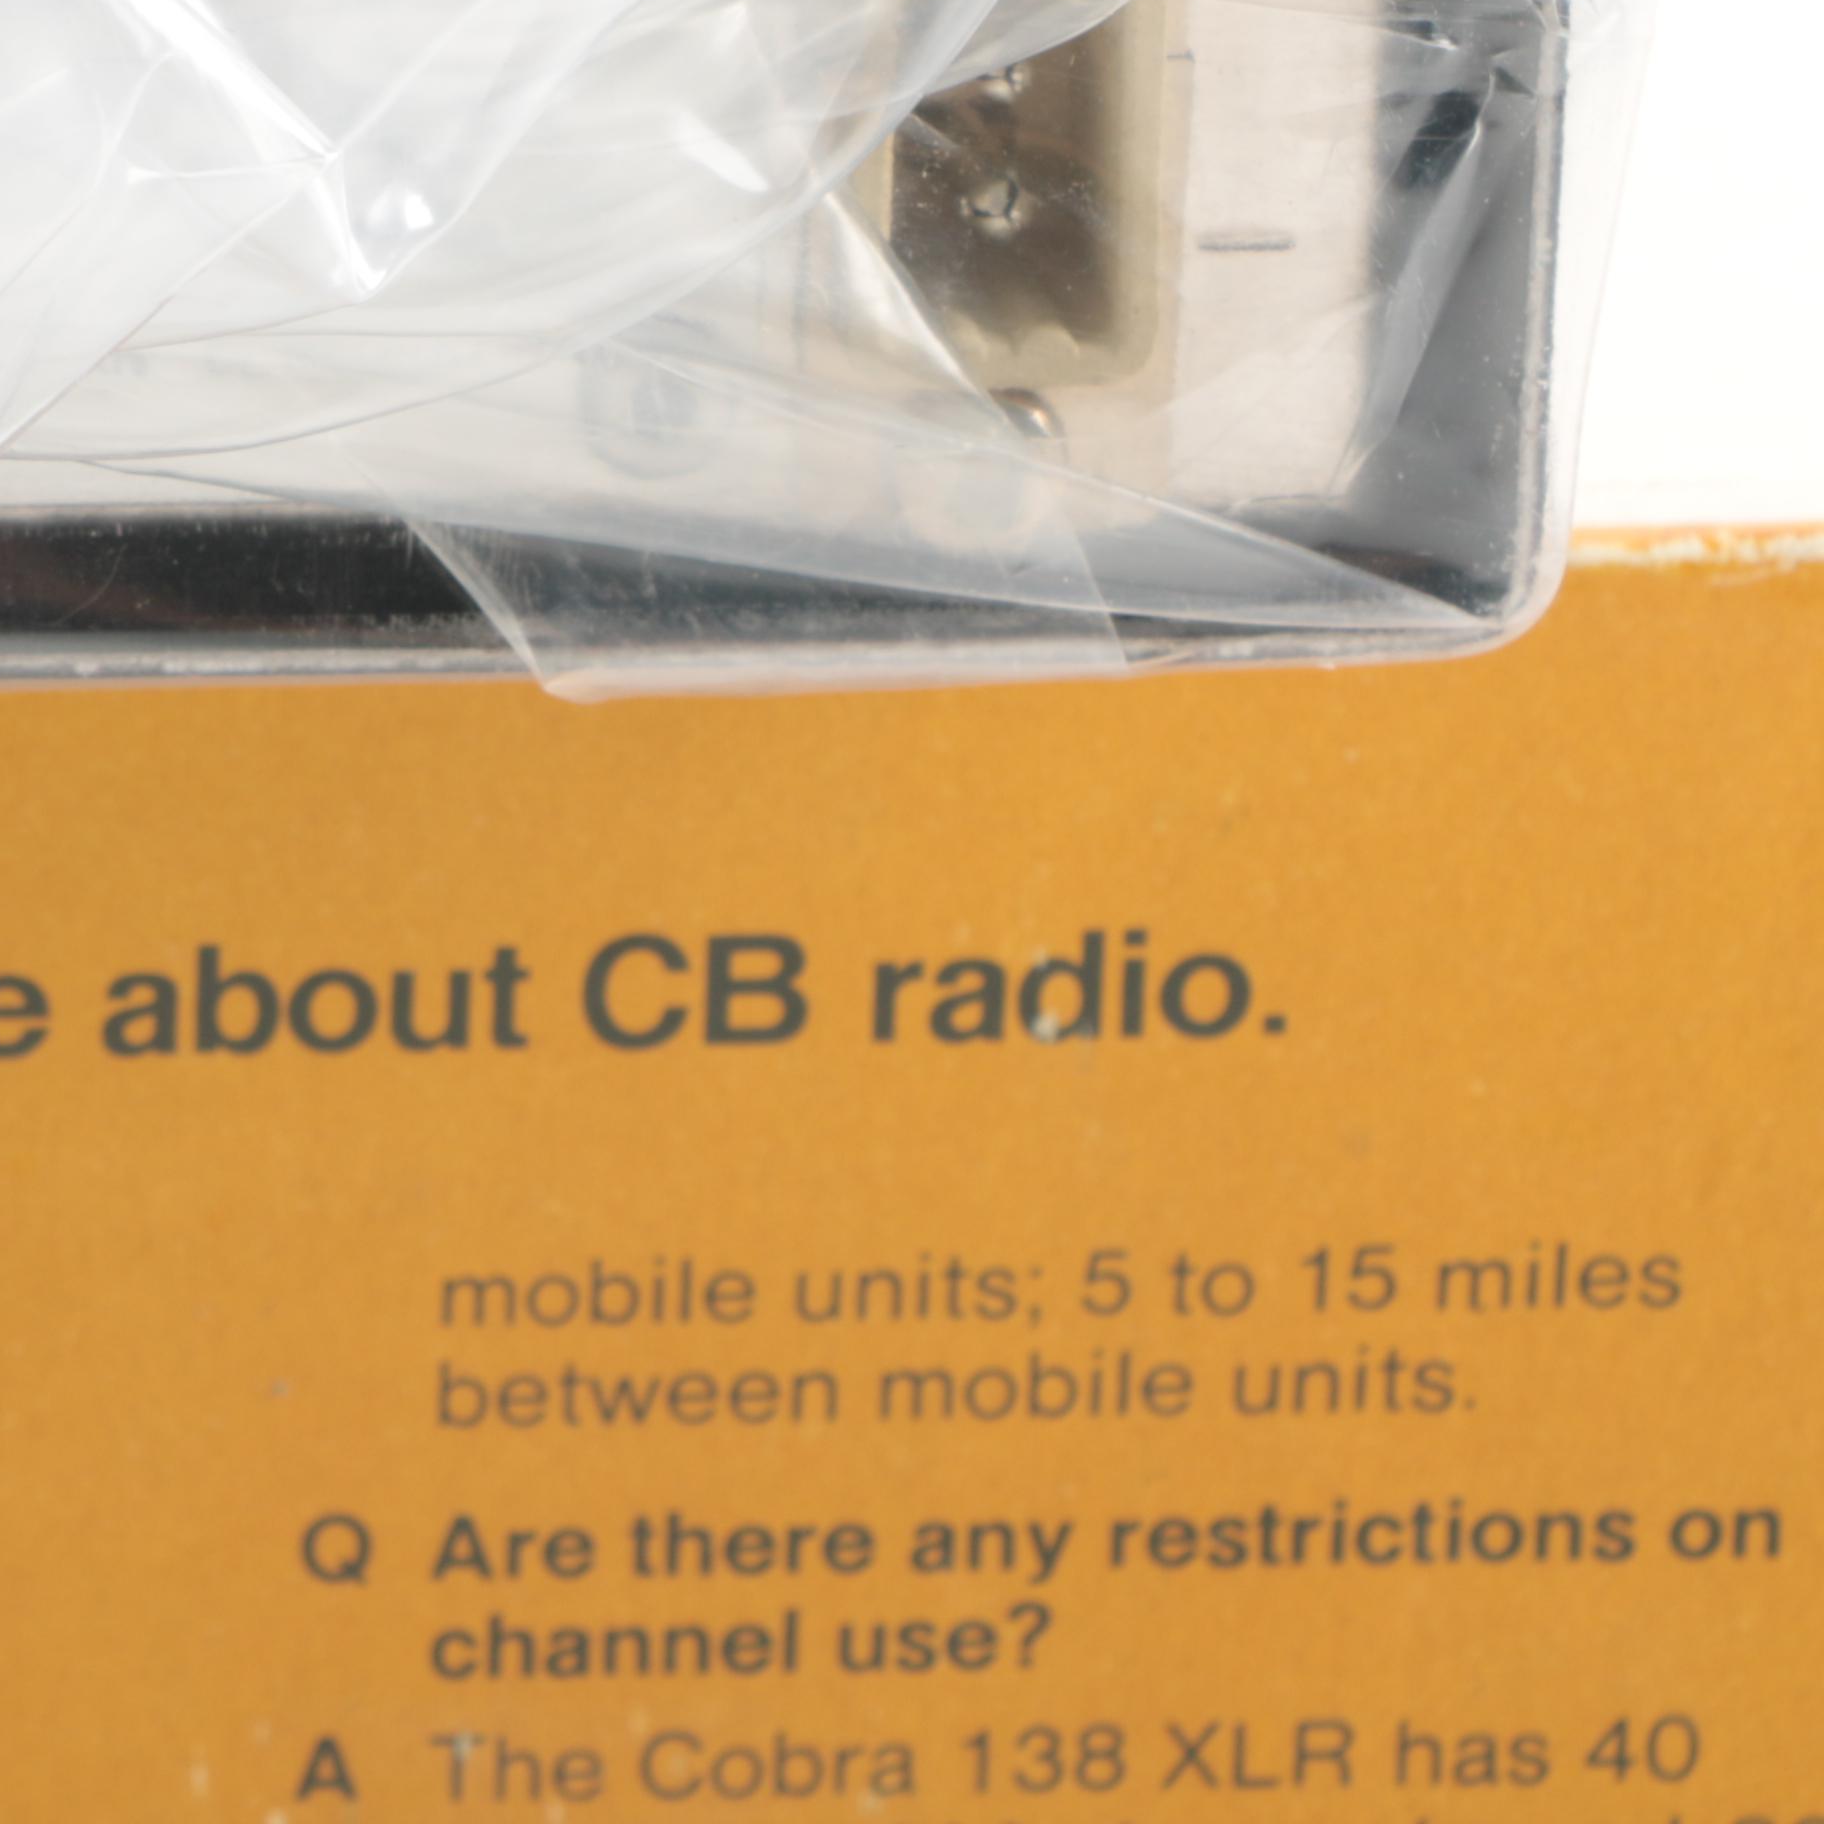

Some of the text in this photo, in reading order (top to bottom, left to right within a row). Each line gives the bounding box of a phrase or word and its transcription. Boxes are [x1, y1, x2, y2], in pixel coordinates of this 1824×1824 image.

[97, 940, 534, 1062] about
[578, 928, 813, 1055] CB
[868, 924, 1291, 1049] radio.
[439, 1257, 759, 1330] mobile
[1079, 1246, 1135, 1319] 5
[1167, 1251, 1258, 1319] to
[1301, 1241, 1400, 1314] 15
[1434, 1240, 1685, 1314] miles
[435, 1346, 1480, 1431] between mobile units.
[297, 1494, 1785, 1588] Q Are there any restrictions on
[427, 1597, 1056, 1684] channel use?
[292, 1711, 1703, 1805] A The Cobra 138 XLR has 40
